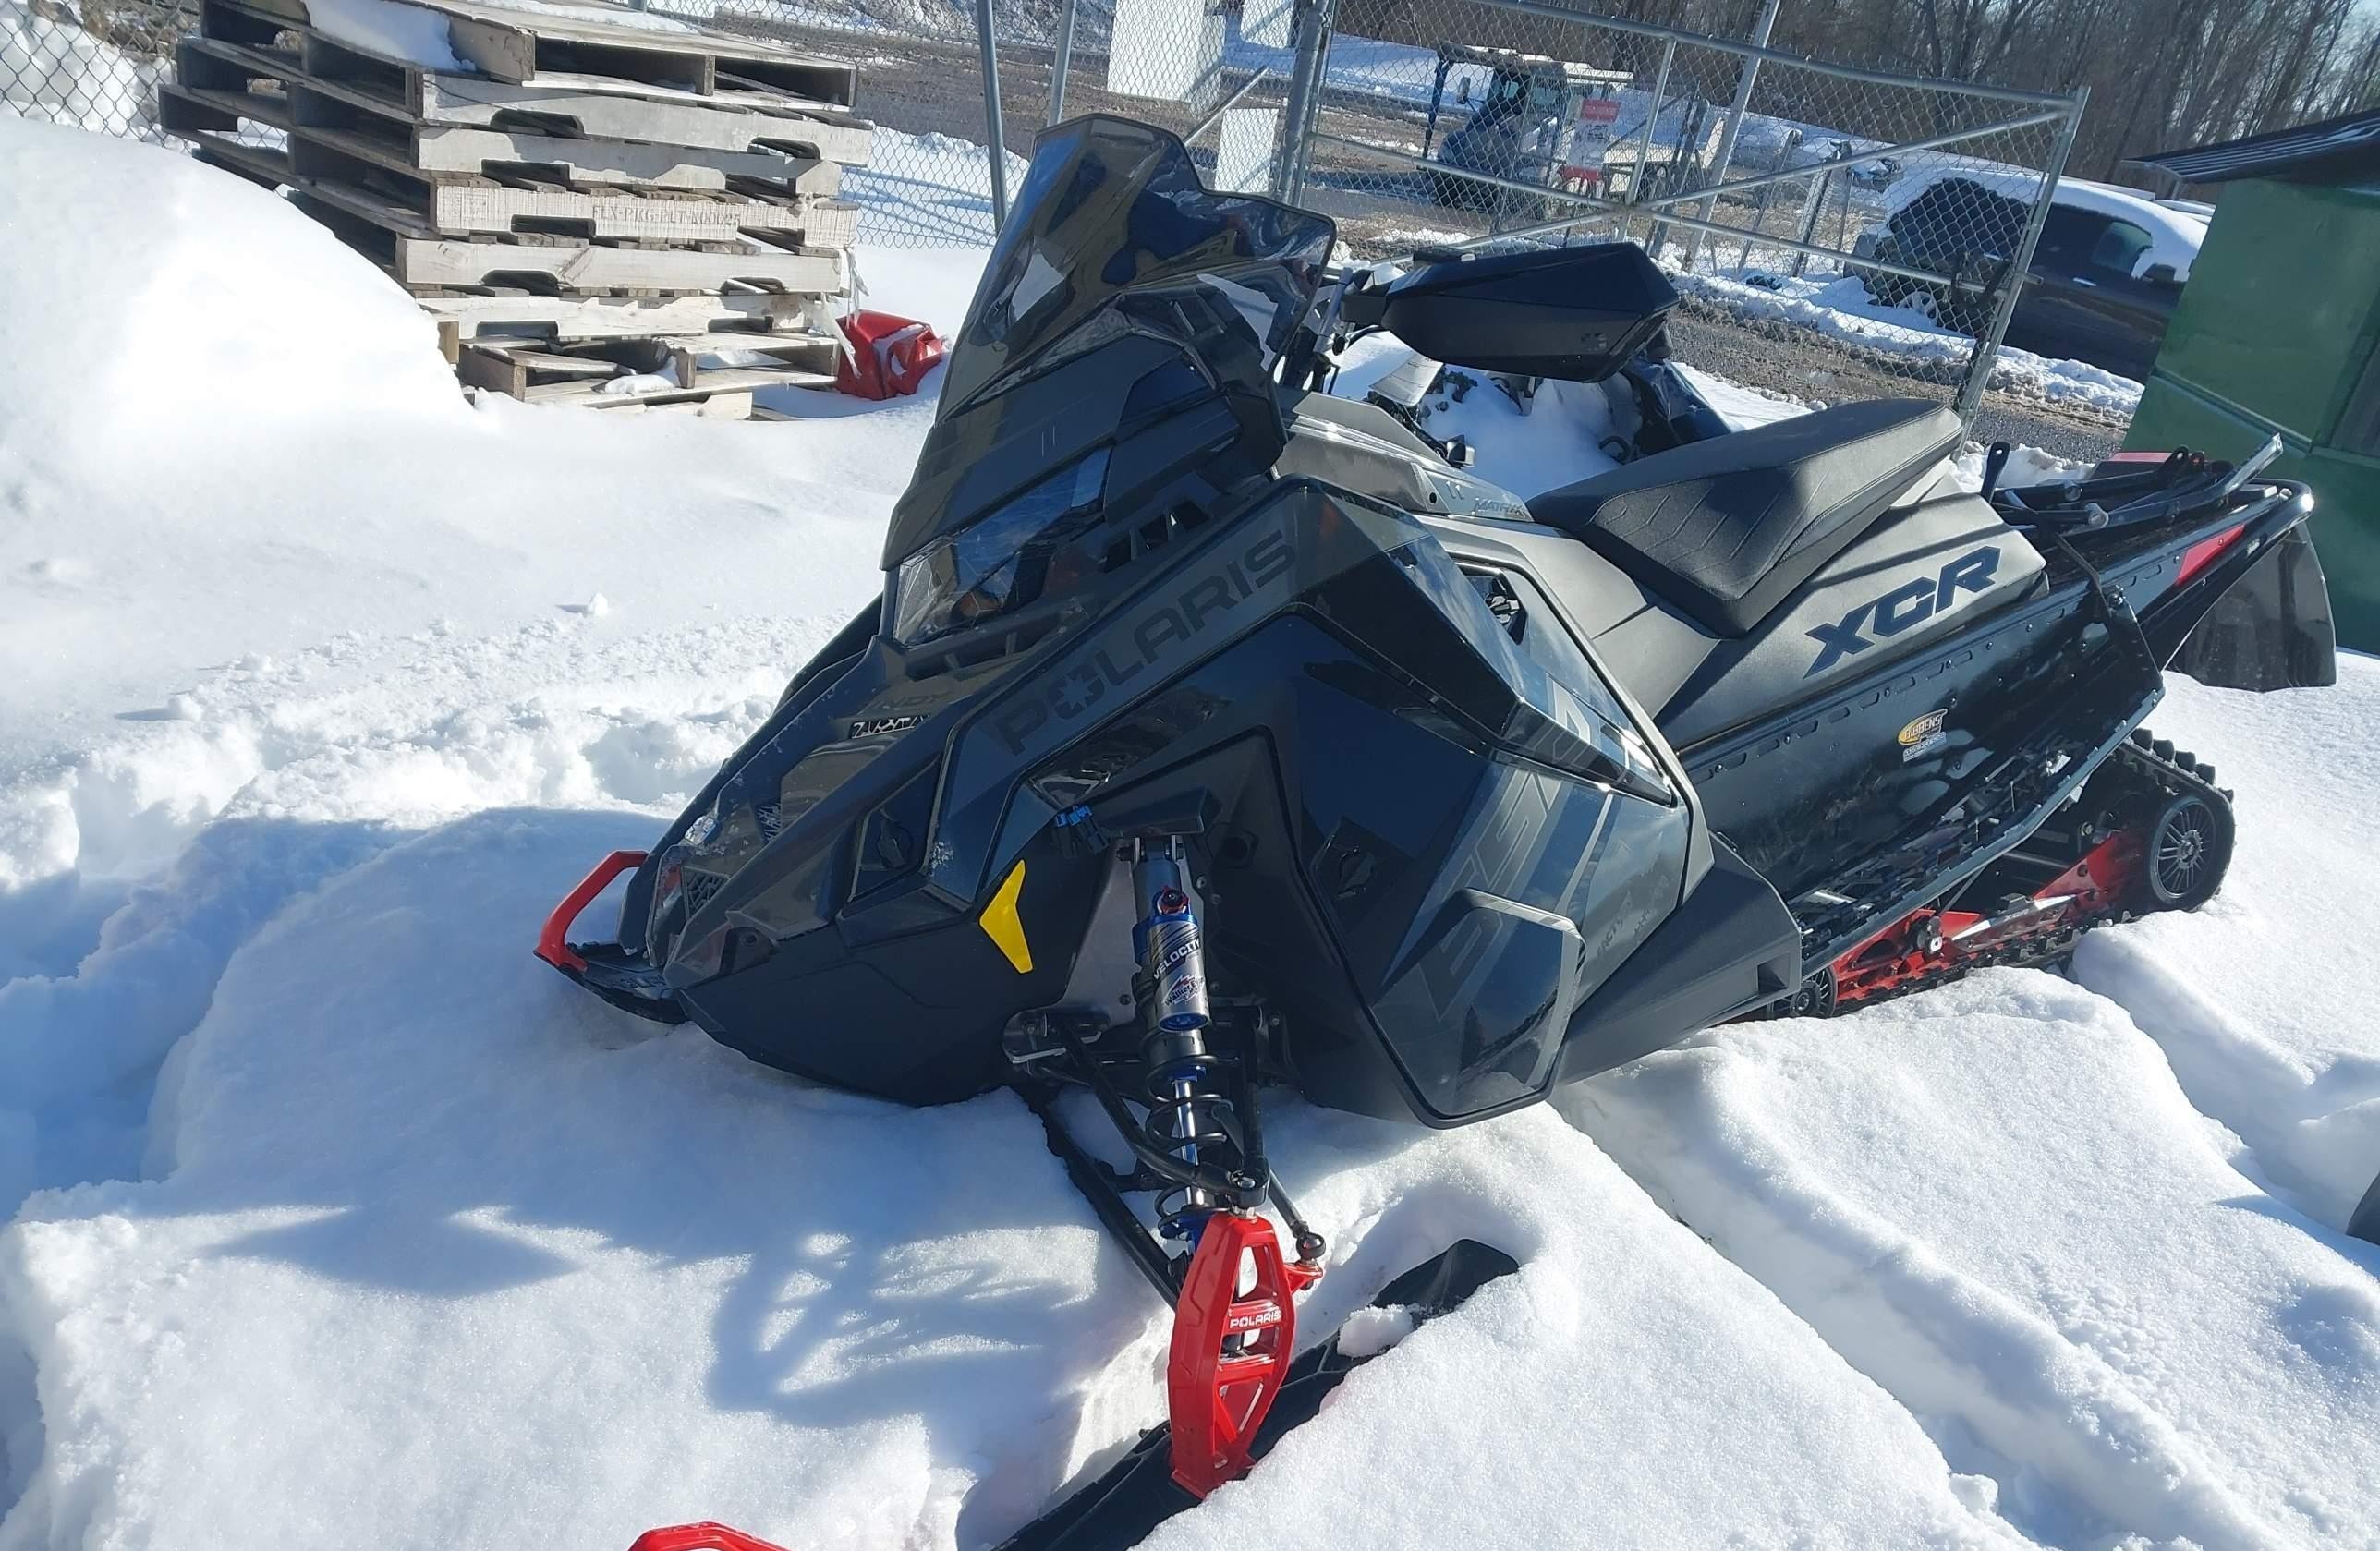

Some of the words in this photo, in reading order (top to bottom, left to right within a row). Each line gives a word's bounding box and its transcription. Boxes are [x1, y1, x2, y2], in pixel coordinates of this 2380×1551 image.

[993, 528, 1295, 756] POLARIS
[1803, 545, 2001, 679] XCR
[1153, 938, 1200, 980] VELOCITY
[1229, 1308, 1281, 1329] POLARIS
